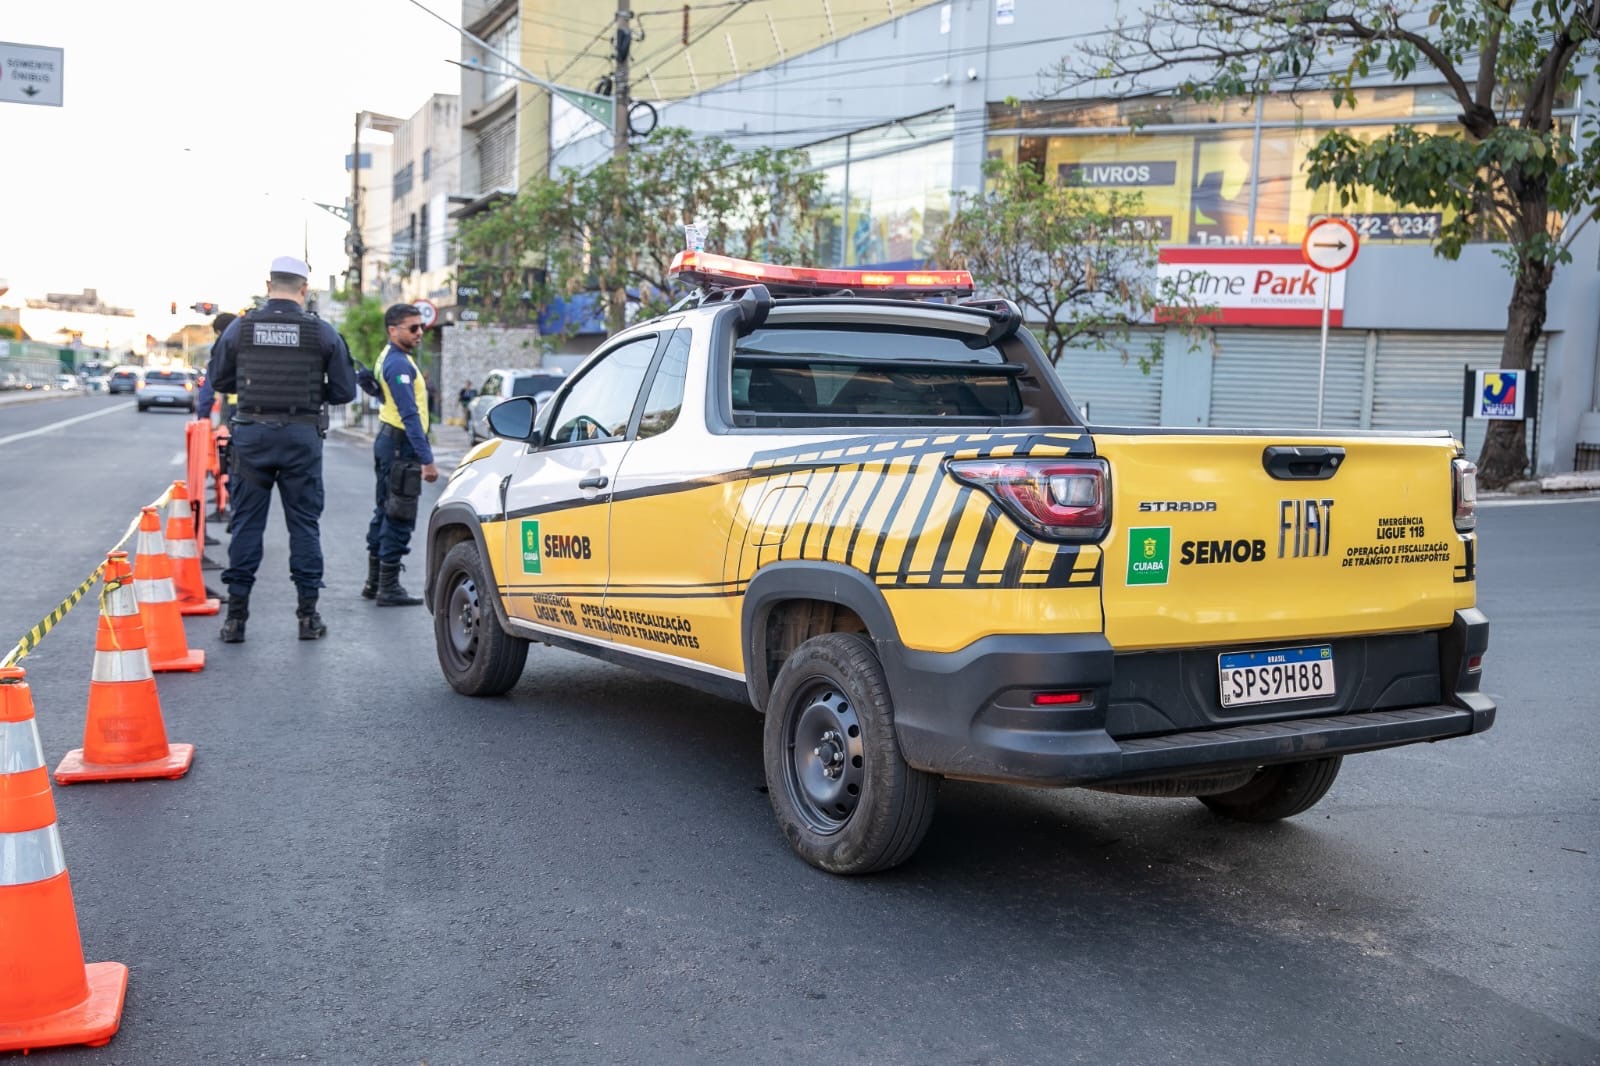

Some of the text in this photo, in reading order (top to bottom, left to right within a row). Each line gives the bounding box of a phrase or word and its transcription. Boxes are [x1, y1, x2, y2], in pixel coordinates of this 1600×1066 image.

[7, 58, 55, 71] SOMENTE
[11, 70, 50, 83] ÔNIBUS
[1082, 165, 1150, 183] LIVROS
[1176, 268, 1320, 296] Prime Park
[255, 329, 298, 345] TRÂNSITO
[1138, 501, 1217, 512] STRADA
[1277, 498, 1335, 558] FIAT
[1378, 515, 1424, 527] EMERGÊNCIA
[1376, 526, 1425, 539] LIGUE 118
[544, 534, 592, 560] SEMOB
[1180, 540, 1266, 565] SEMOB
[1346, 541, 1449, 557] OPERAÇÃO E FISCALIZAÇÃO
[1133, 559, 1164, 570] CUIABÁ
[1342, 552, 1450, 567] DE TRÂNSITO E TRANSPORTES
[533, 604, 578, 626] LIGUE 118
[580, 603, 693, 633] OPERAÇÃO E FISCALIZAÇÃO
[581, 617, 700, 649] DE TRÂNSITO E TRANSPORTES
[1267, 655, 1286, 663] BRASIL
[1231, 662, 1323, 698] SPS9H88
